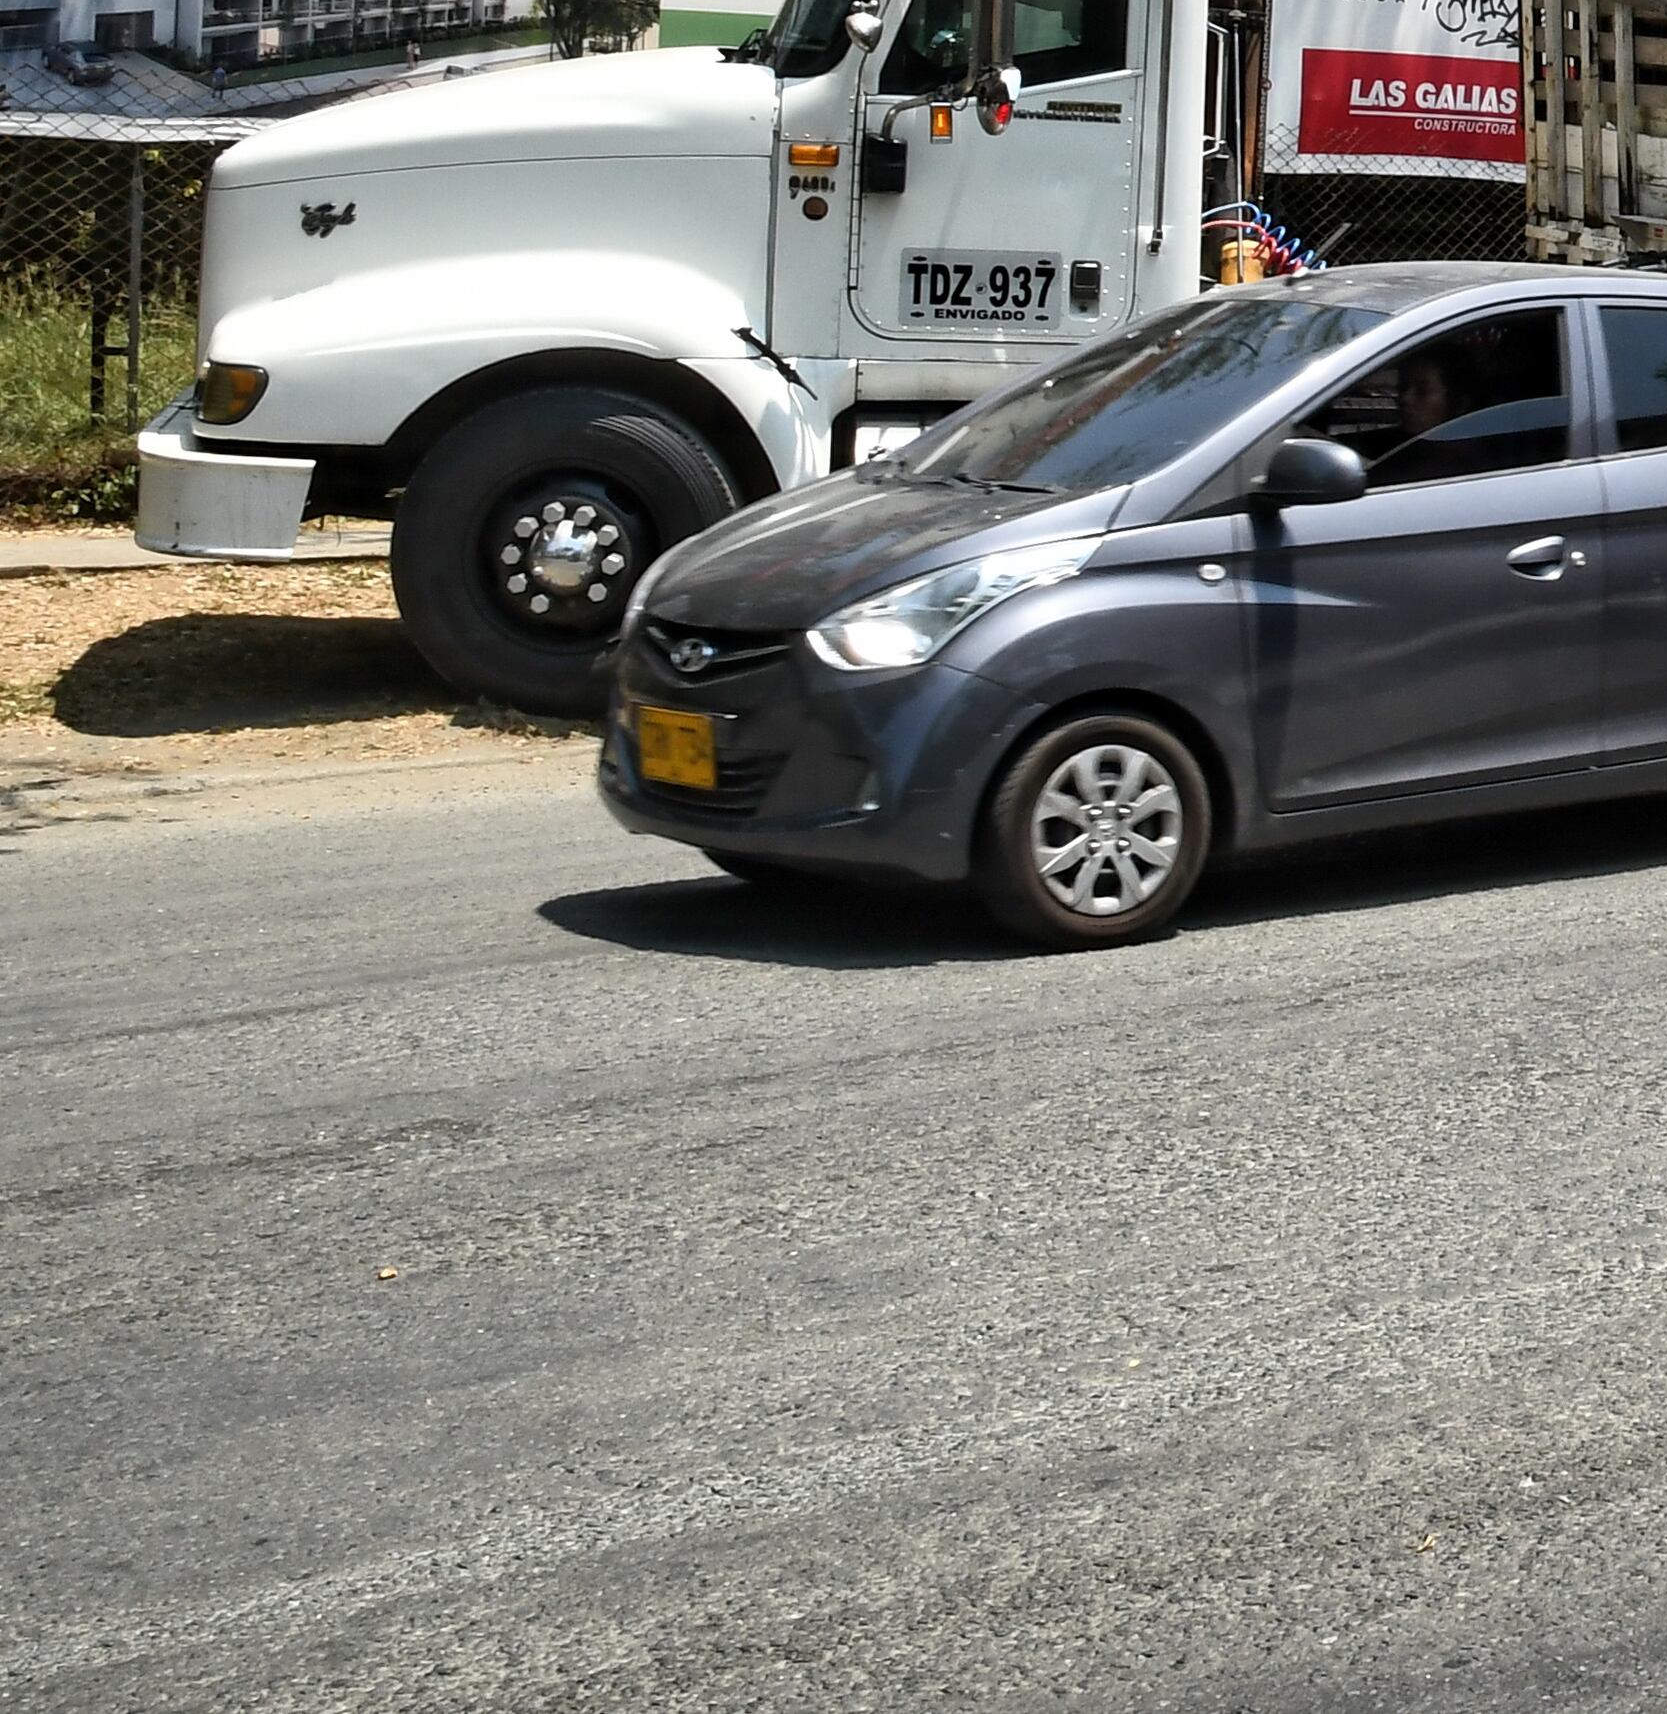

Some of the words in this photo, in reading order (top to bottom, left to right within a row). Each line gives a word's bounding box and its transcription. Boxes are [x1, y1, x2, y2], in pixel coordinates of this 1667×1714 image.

[1349, 79, 1406, 108] LAS
[1415, 82, 1518, 115] GALIAS
[1413, 118, 1517, 136] CONSTRUCTORA
[907, 262, 974, 306] TDZ
[988, 264, 1056, 308] 937
[934, 308, 1026, 322] ENVIGADO
